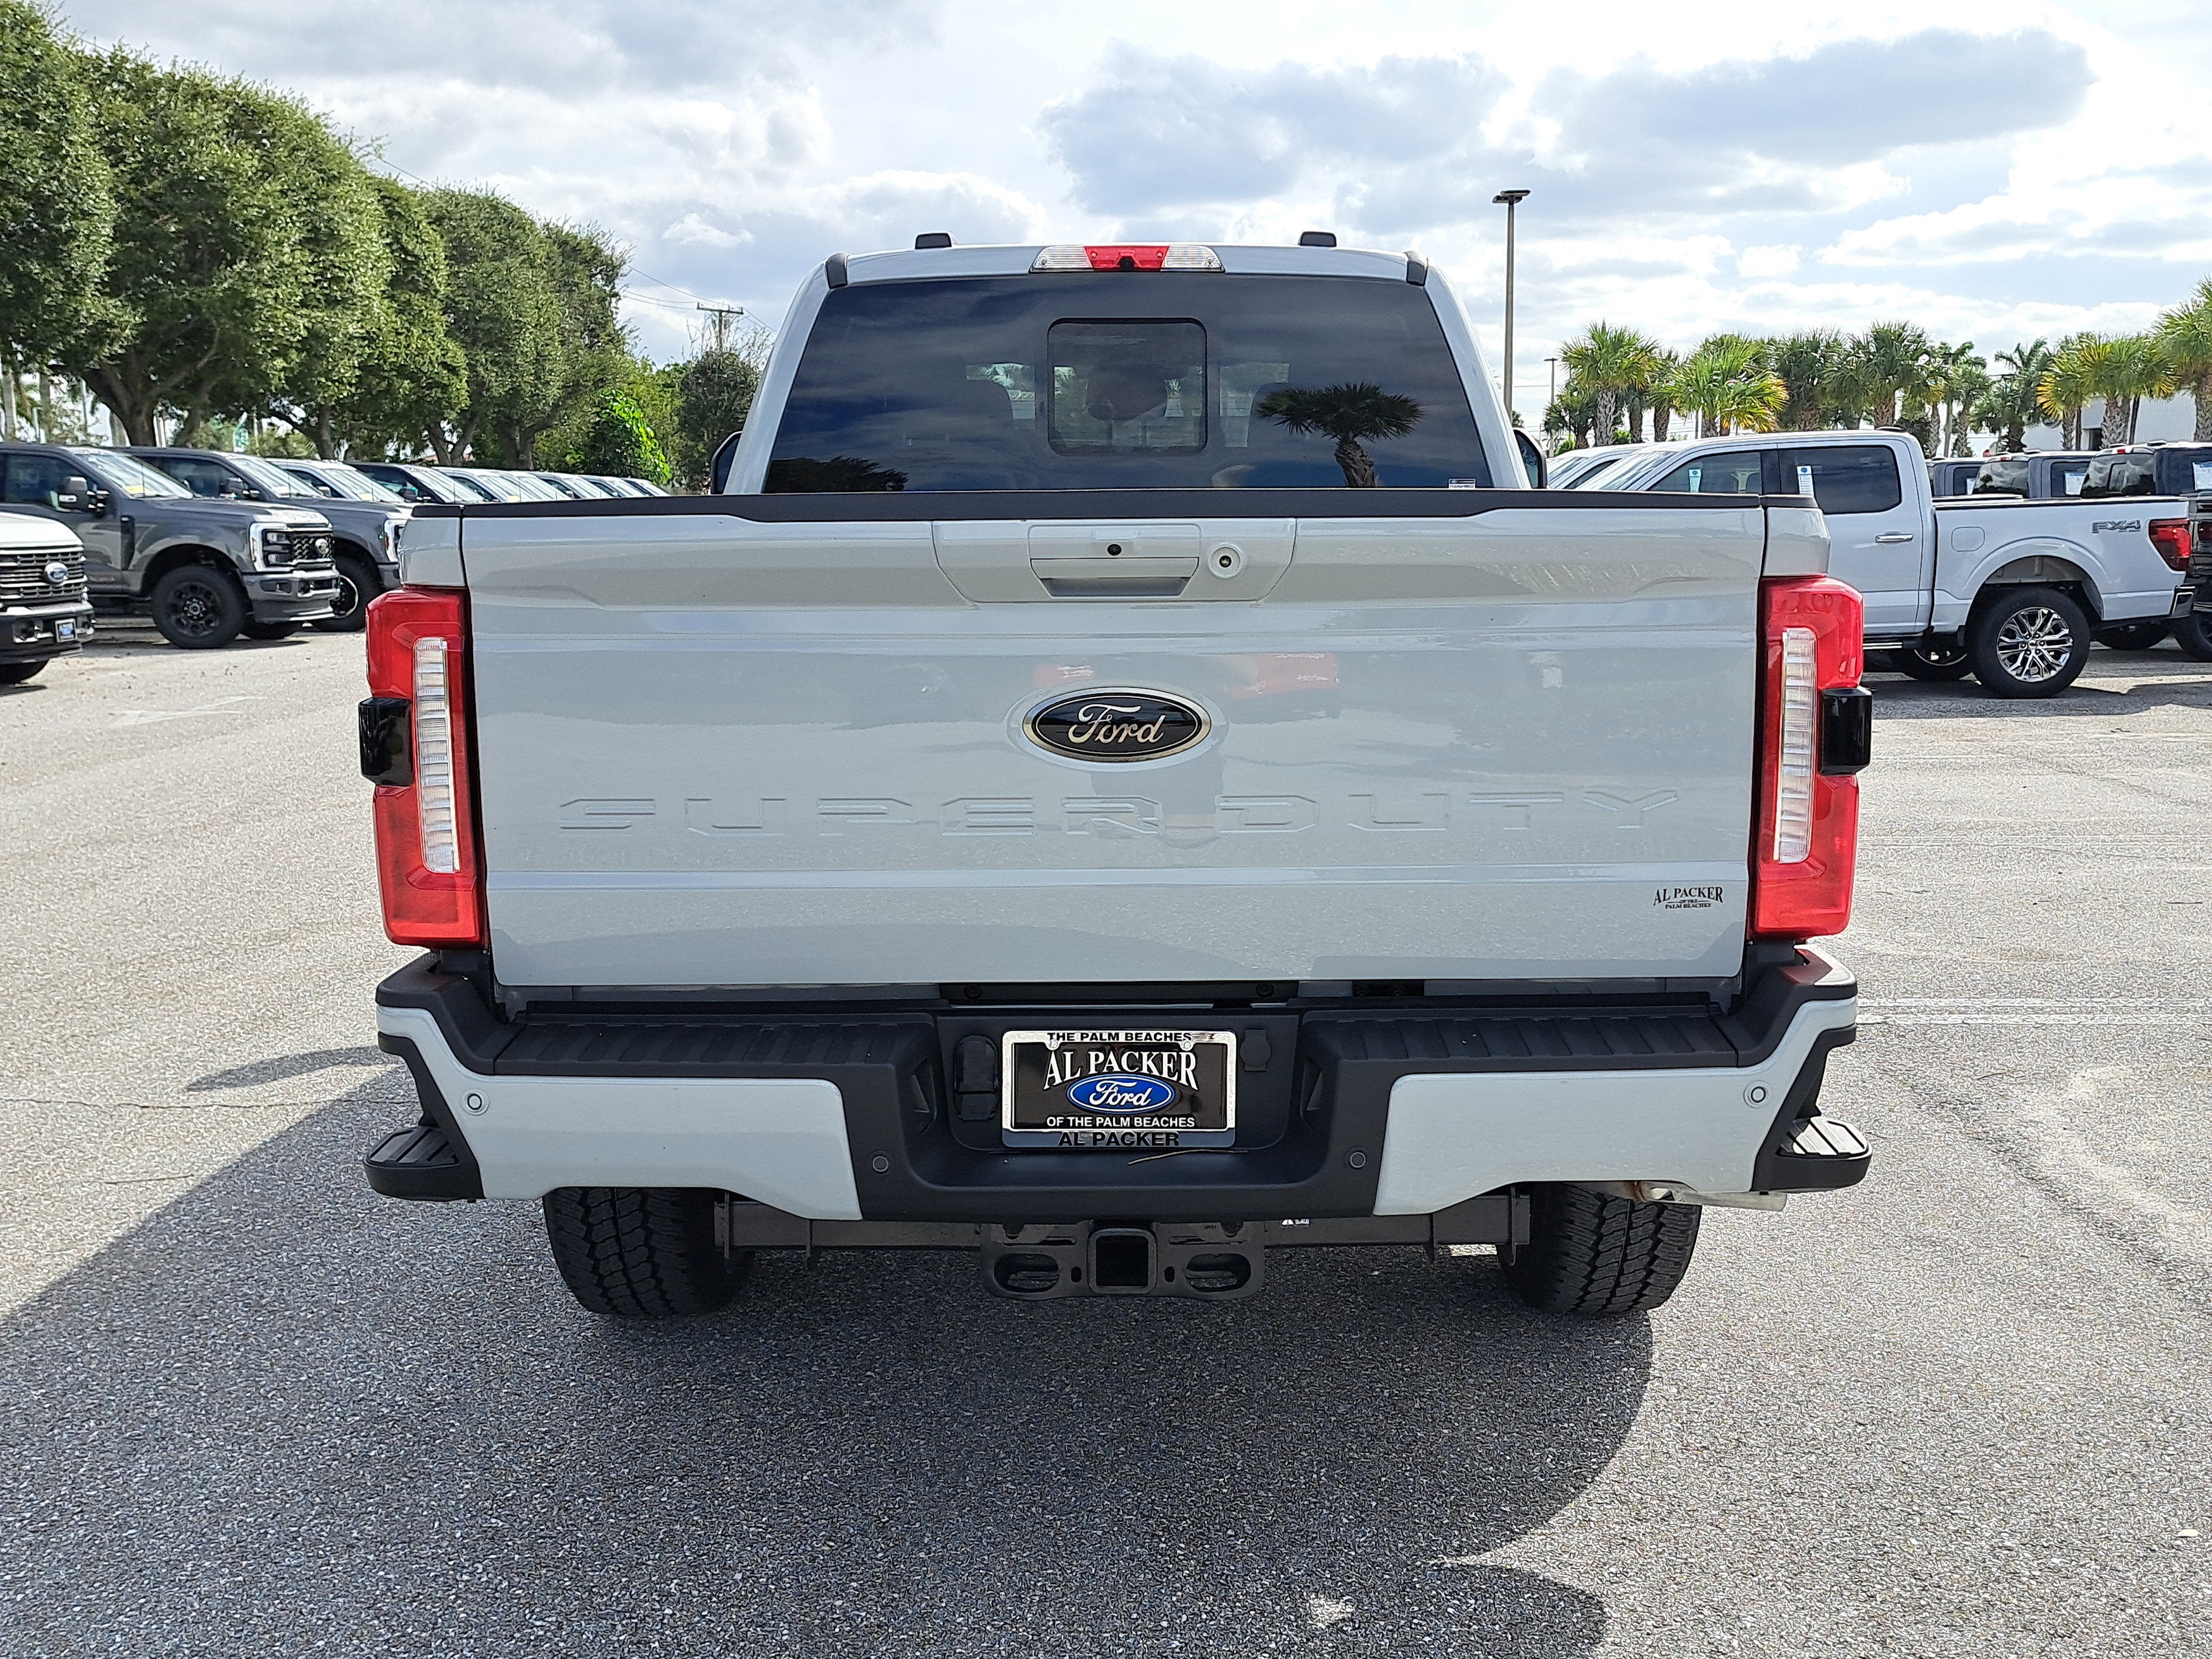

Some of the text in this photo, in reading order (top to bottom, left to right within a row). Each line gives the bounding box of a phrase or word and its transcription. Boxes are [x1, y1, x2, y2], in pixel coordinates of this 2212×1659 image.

[2092, 520, 2141, 533] FX4
[1068, 703, 1168, 744] Ford
[559, 790, 1678, 837] SUPER DUTY
[1653, 886, 1724, 906] AL PACKER
[1047, 1032, 1193, 1042] THE PALM BEACHES
[1043, 1051, 1198, 1091] AL PACKER
[1089, 1080, 1153, 1106] Ford
[1046, 1117, 1195, 1128] OF THE PALM BEACHES
[1058, 1131, 1180, 1147] AL PACKER
